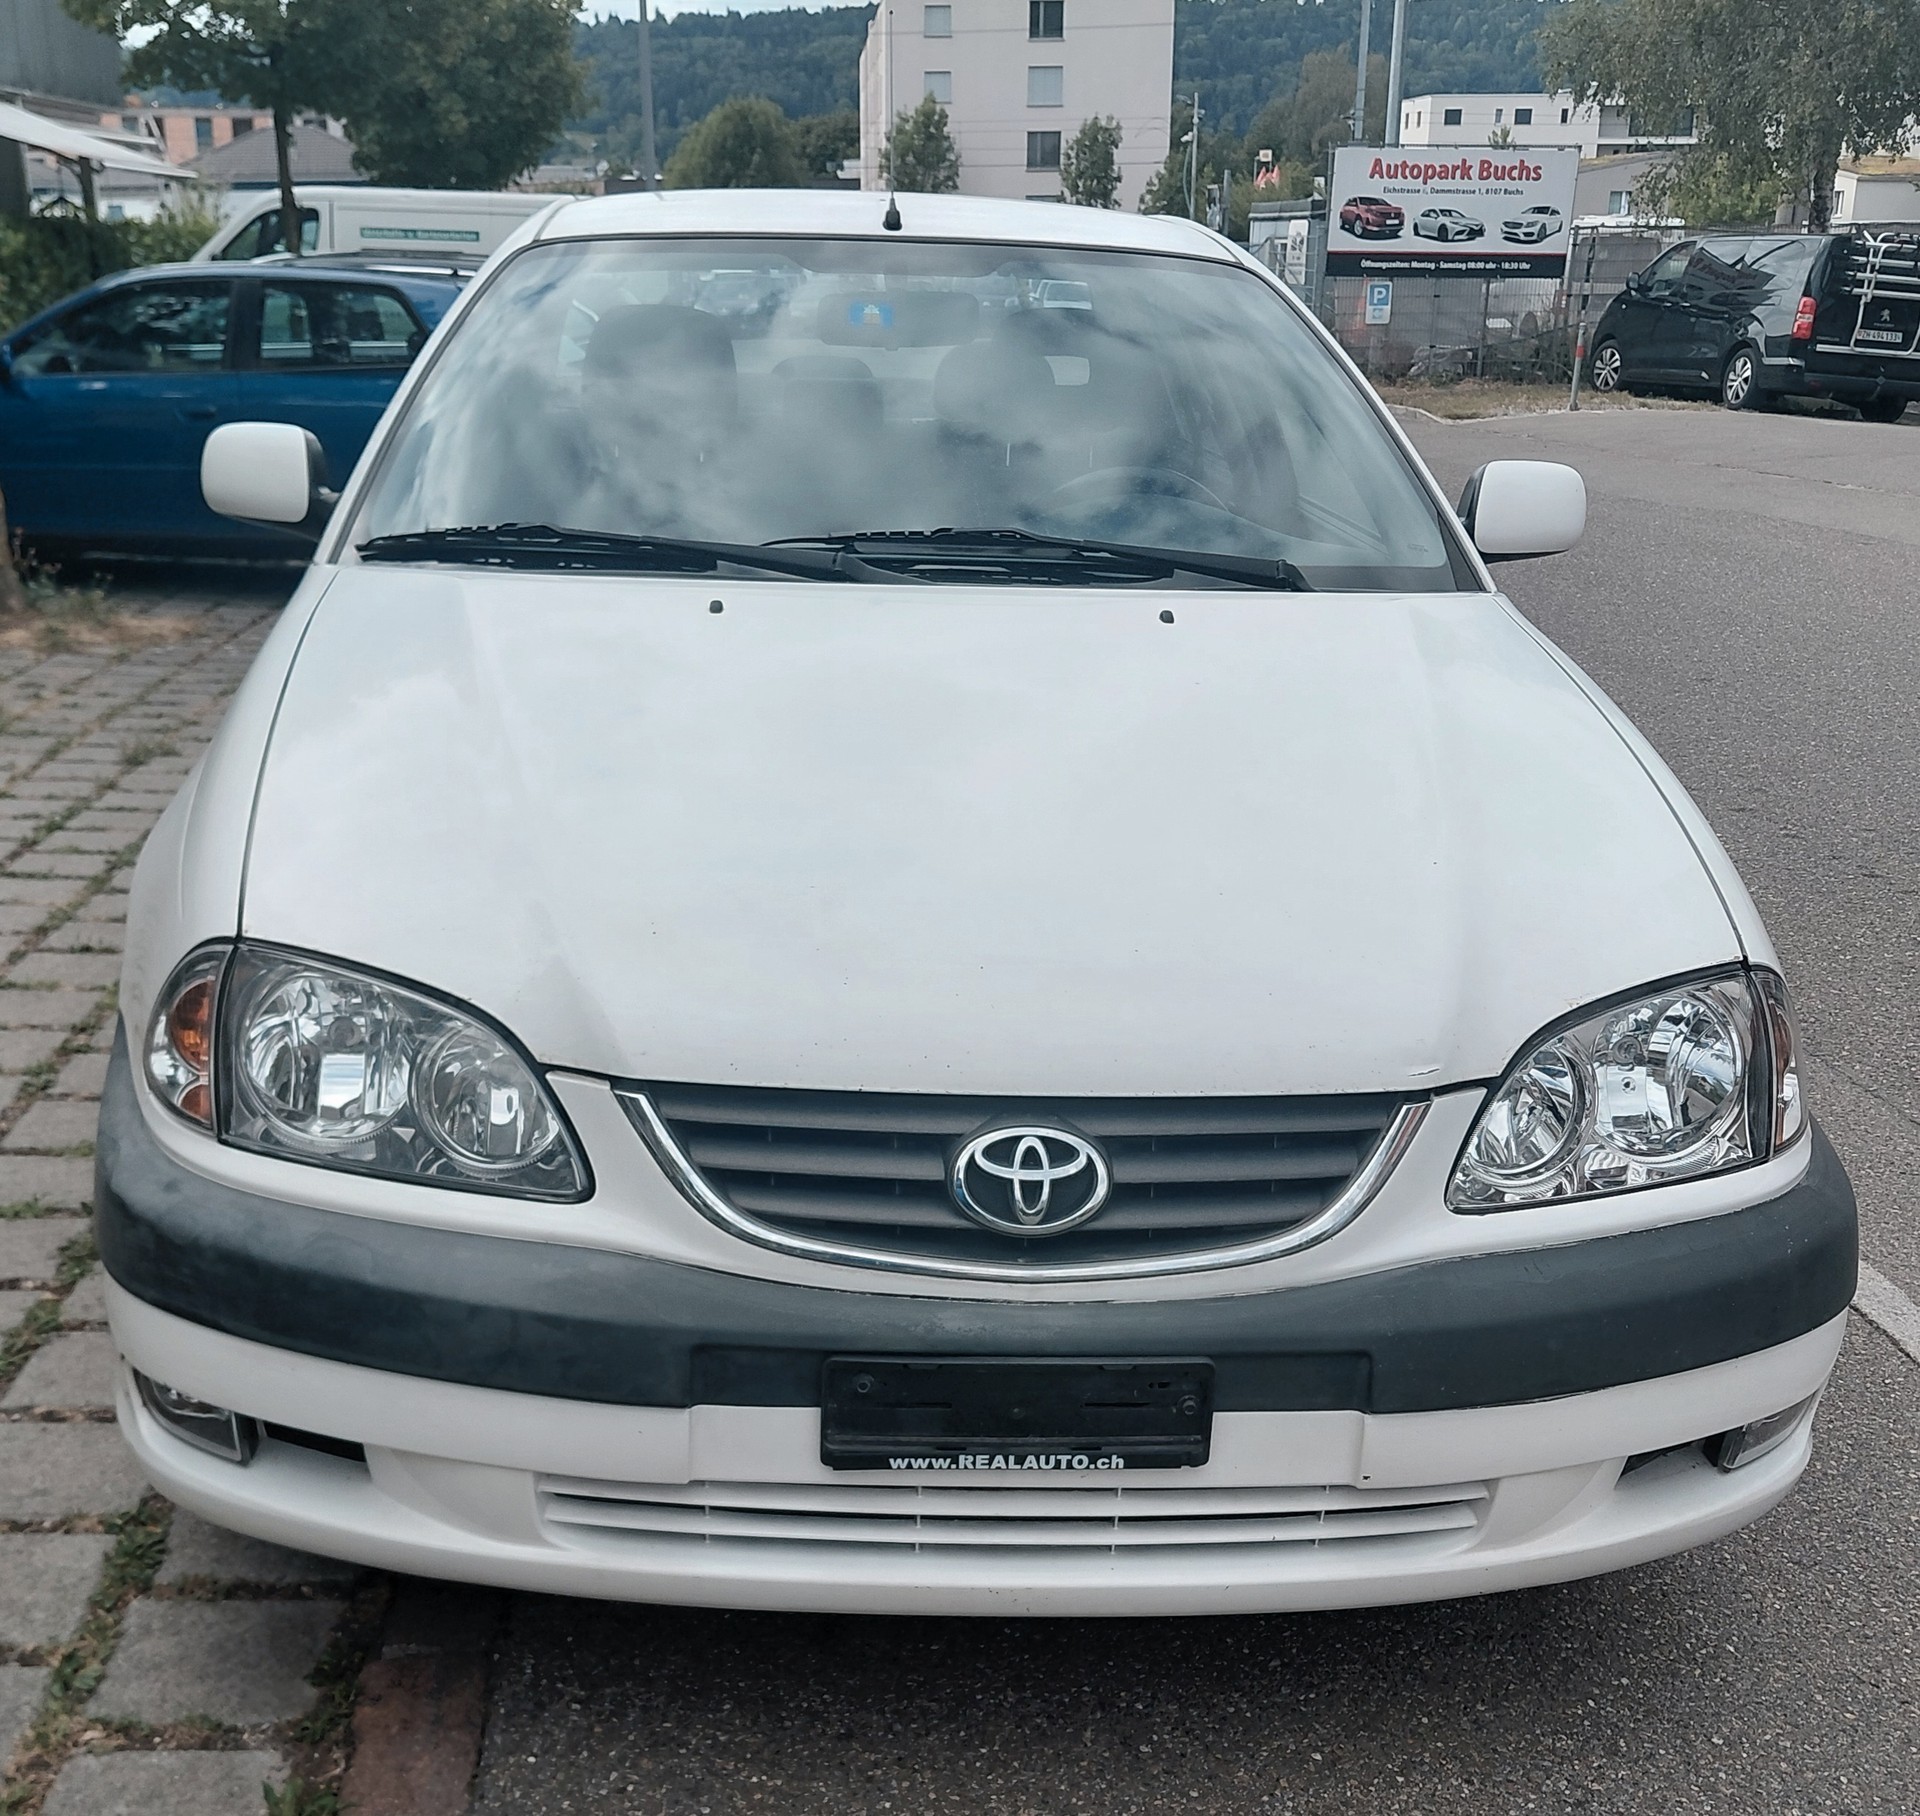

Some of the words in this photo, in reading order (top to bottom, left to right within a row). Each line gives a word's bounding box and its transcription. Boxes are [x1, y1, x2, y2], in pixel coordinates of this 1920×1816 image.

[1369, 158, 1473, 185] Autopark
[1478, 158, 1543, 181] Buchs
[1383, 186, 1421, 194] Eichstrasse
[1430, 187, 1476, 195] Dammstrasse
[1440, 261, 1466, 270] Samstag
[1373, 287, 1387, 304] P
[889, 1454, 1125, 1470] www.REALAUTO.ch
